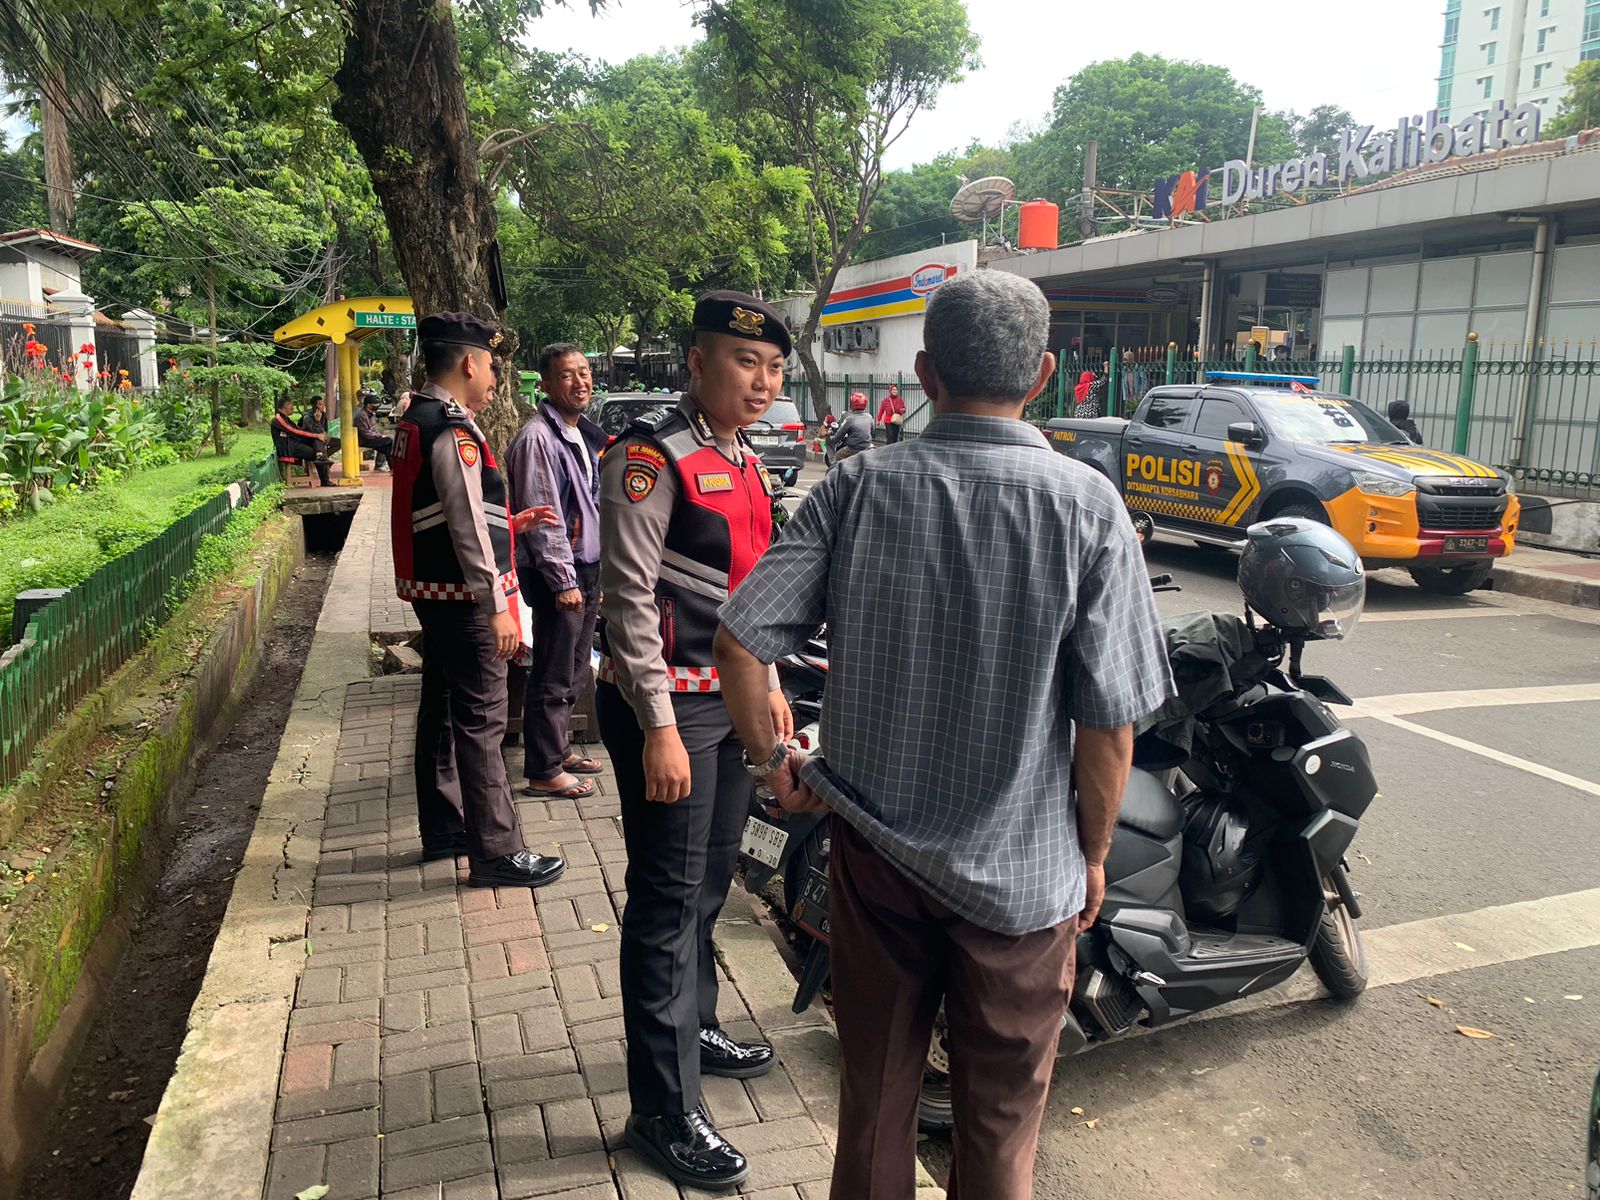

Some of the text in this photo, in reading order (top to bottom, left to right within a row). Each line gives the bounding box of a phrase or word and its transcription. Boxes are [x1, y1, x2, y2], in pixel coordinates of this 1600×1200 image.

[1222, 151, 1328, 206] Duren
[1338, 99, 1542, 183] Kalibata
[366, 314, 394, 325] HALTE
[1053, 431, 1077, 442] PATROLI
[1126, 453, 1201, 487] POLISI
[703, 476, 729, 488] KRISNA
[1126, 480, 1160, 495] DITSAMAPTA
[804, 878, 813, 897] B
